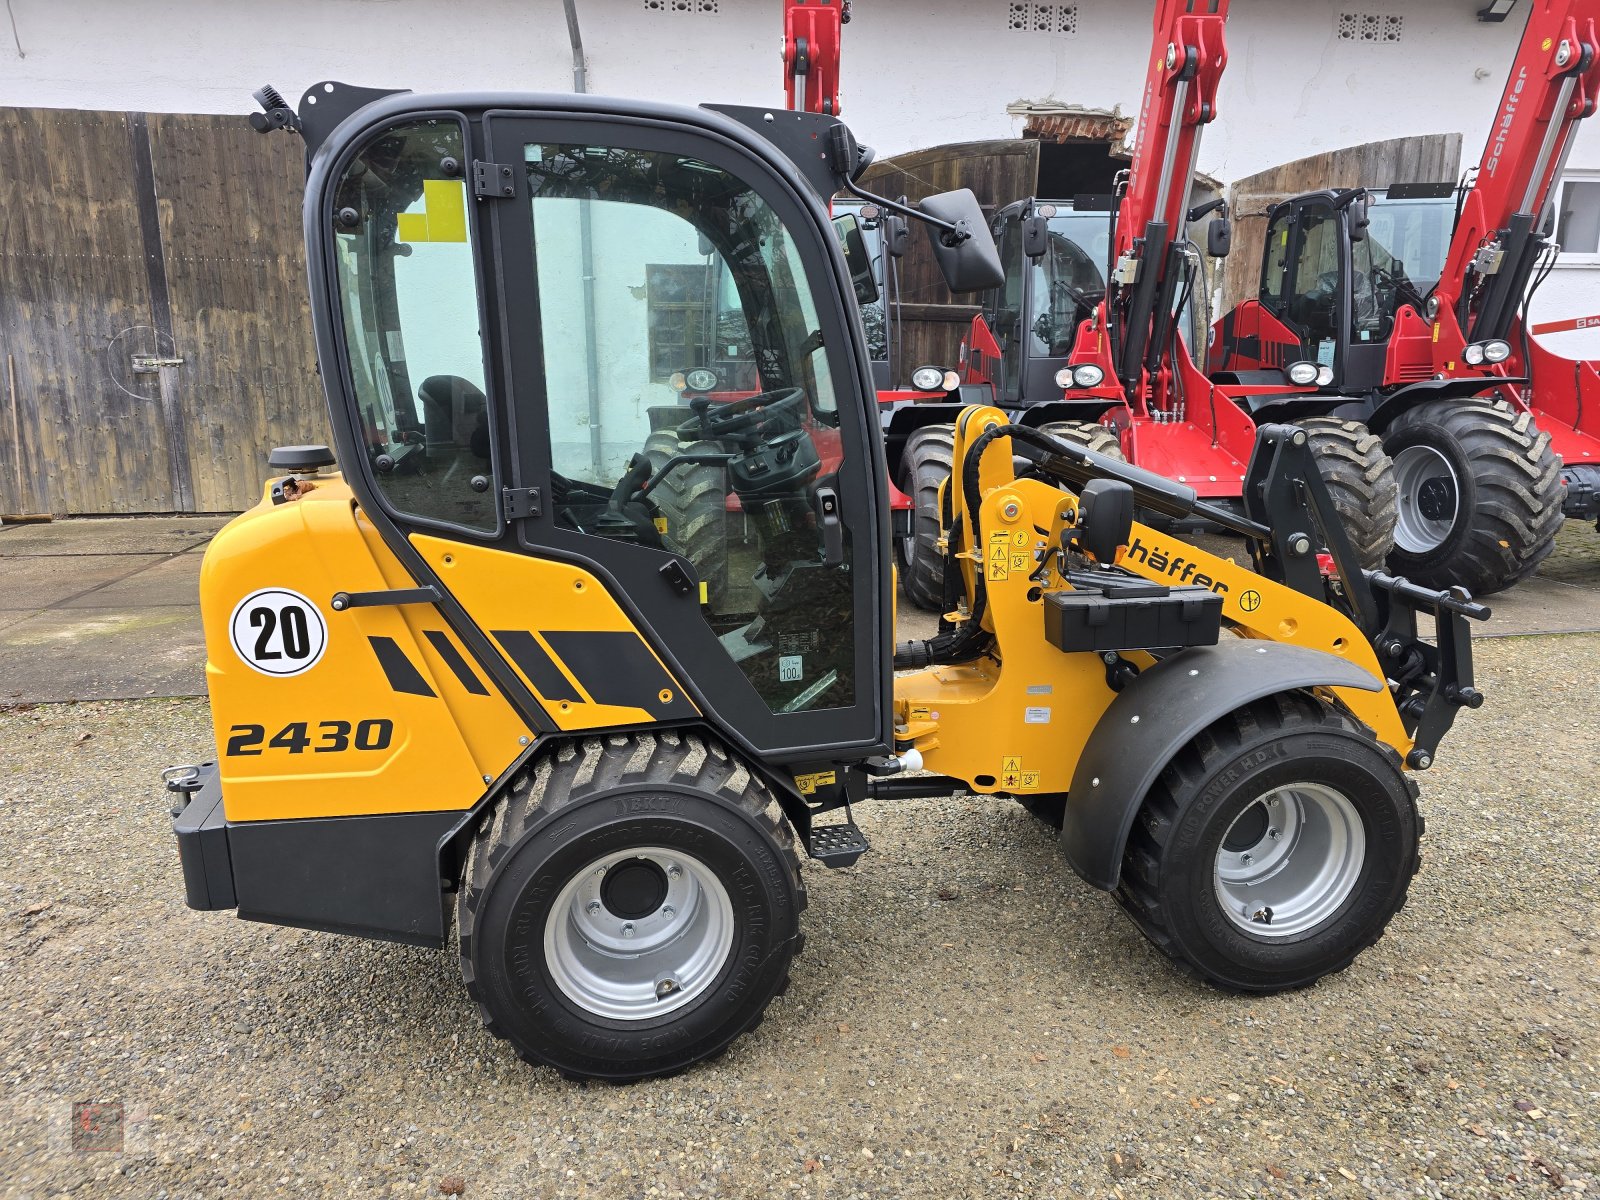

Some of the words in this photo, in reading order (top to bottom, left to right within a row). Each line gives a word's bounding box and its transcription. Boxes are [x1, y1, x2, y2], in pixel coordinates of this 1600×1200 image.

[1486, 66, 1527, 178] Schäffer
[1127, 537, 1229, 594] häffer
[250, 605, 310, 660] 20
[781, 667, 797, 680] 100
[226, 718, 394, 757] 2430
[1196, 769, 1240, 813] POWER
[1240, 751, 1272, 771] H.D.
